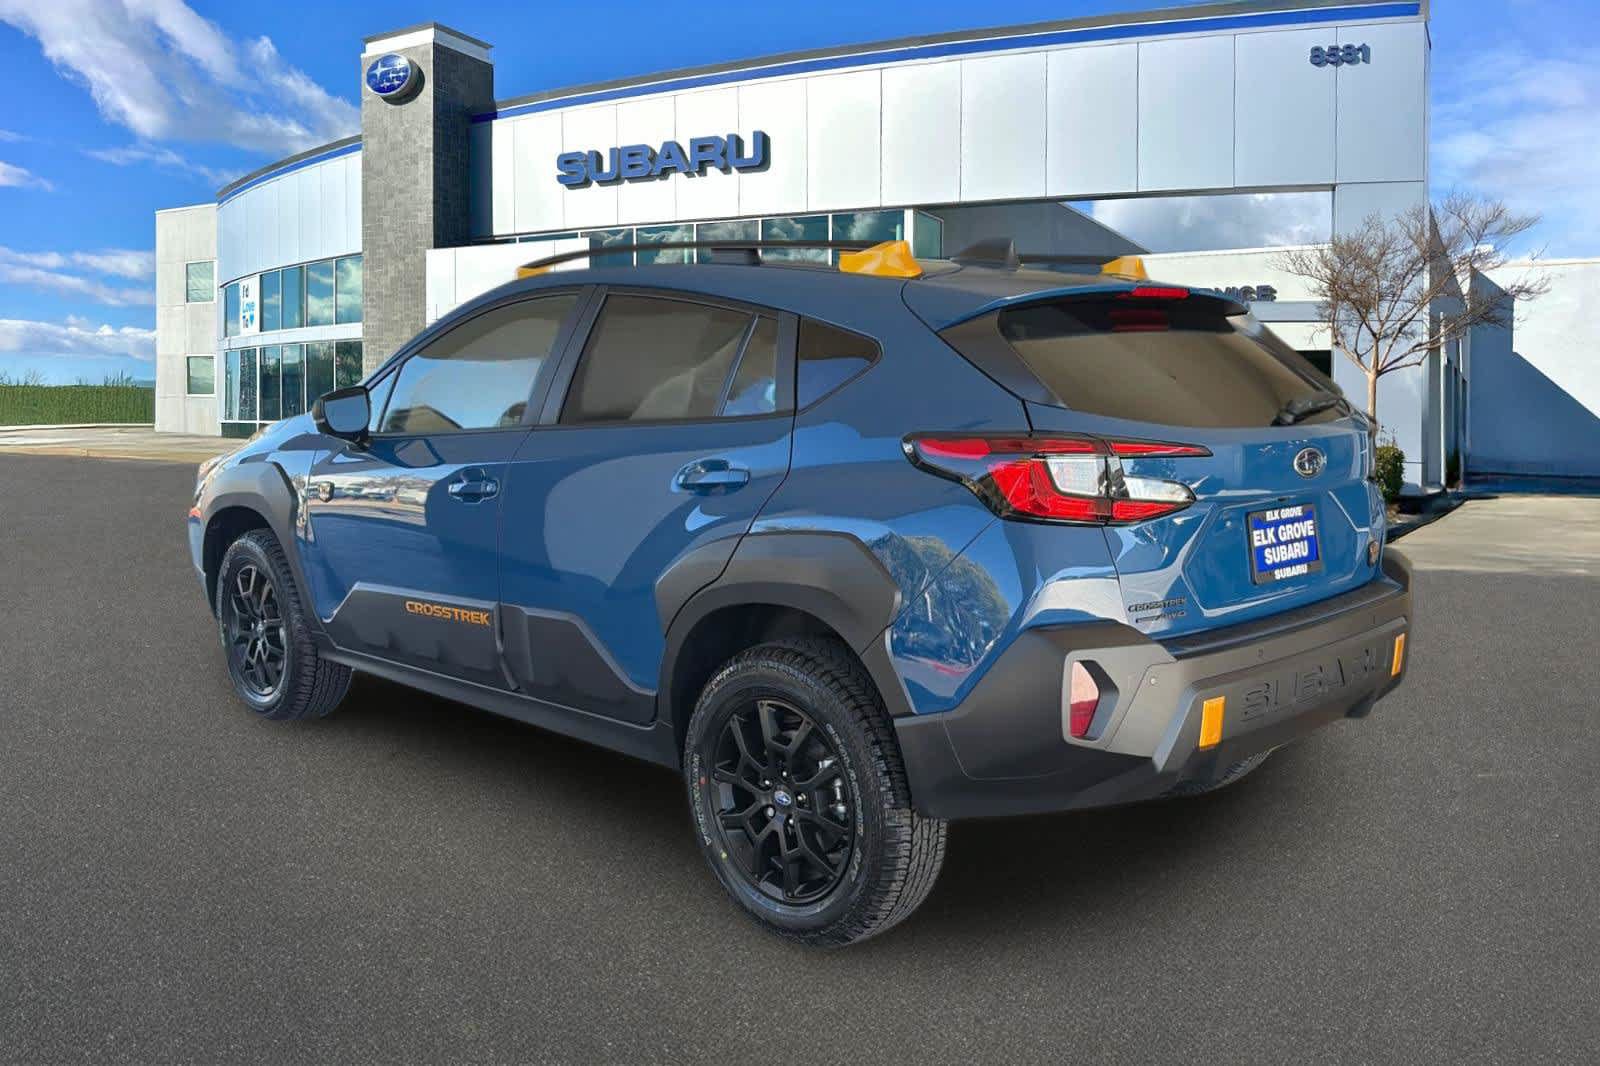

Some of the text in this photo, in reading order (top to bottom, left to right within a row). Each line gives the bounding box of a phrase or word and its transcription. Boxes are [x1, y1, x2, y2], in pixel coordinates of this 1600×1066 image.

[1309, 43, 1371, 68] 8531
[556, 130, 771, 190] SUBARU
[1265, 506, 1303, 521] ELK GROVE
[1253, 519, 1315, 547] ELK GROVE
[1264, 540, 1309, 565] SUBARU
[1274, 563, 1308, 580] SUBARU
[405, 600, 490, 625] CROSSTREK
